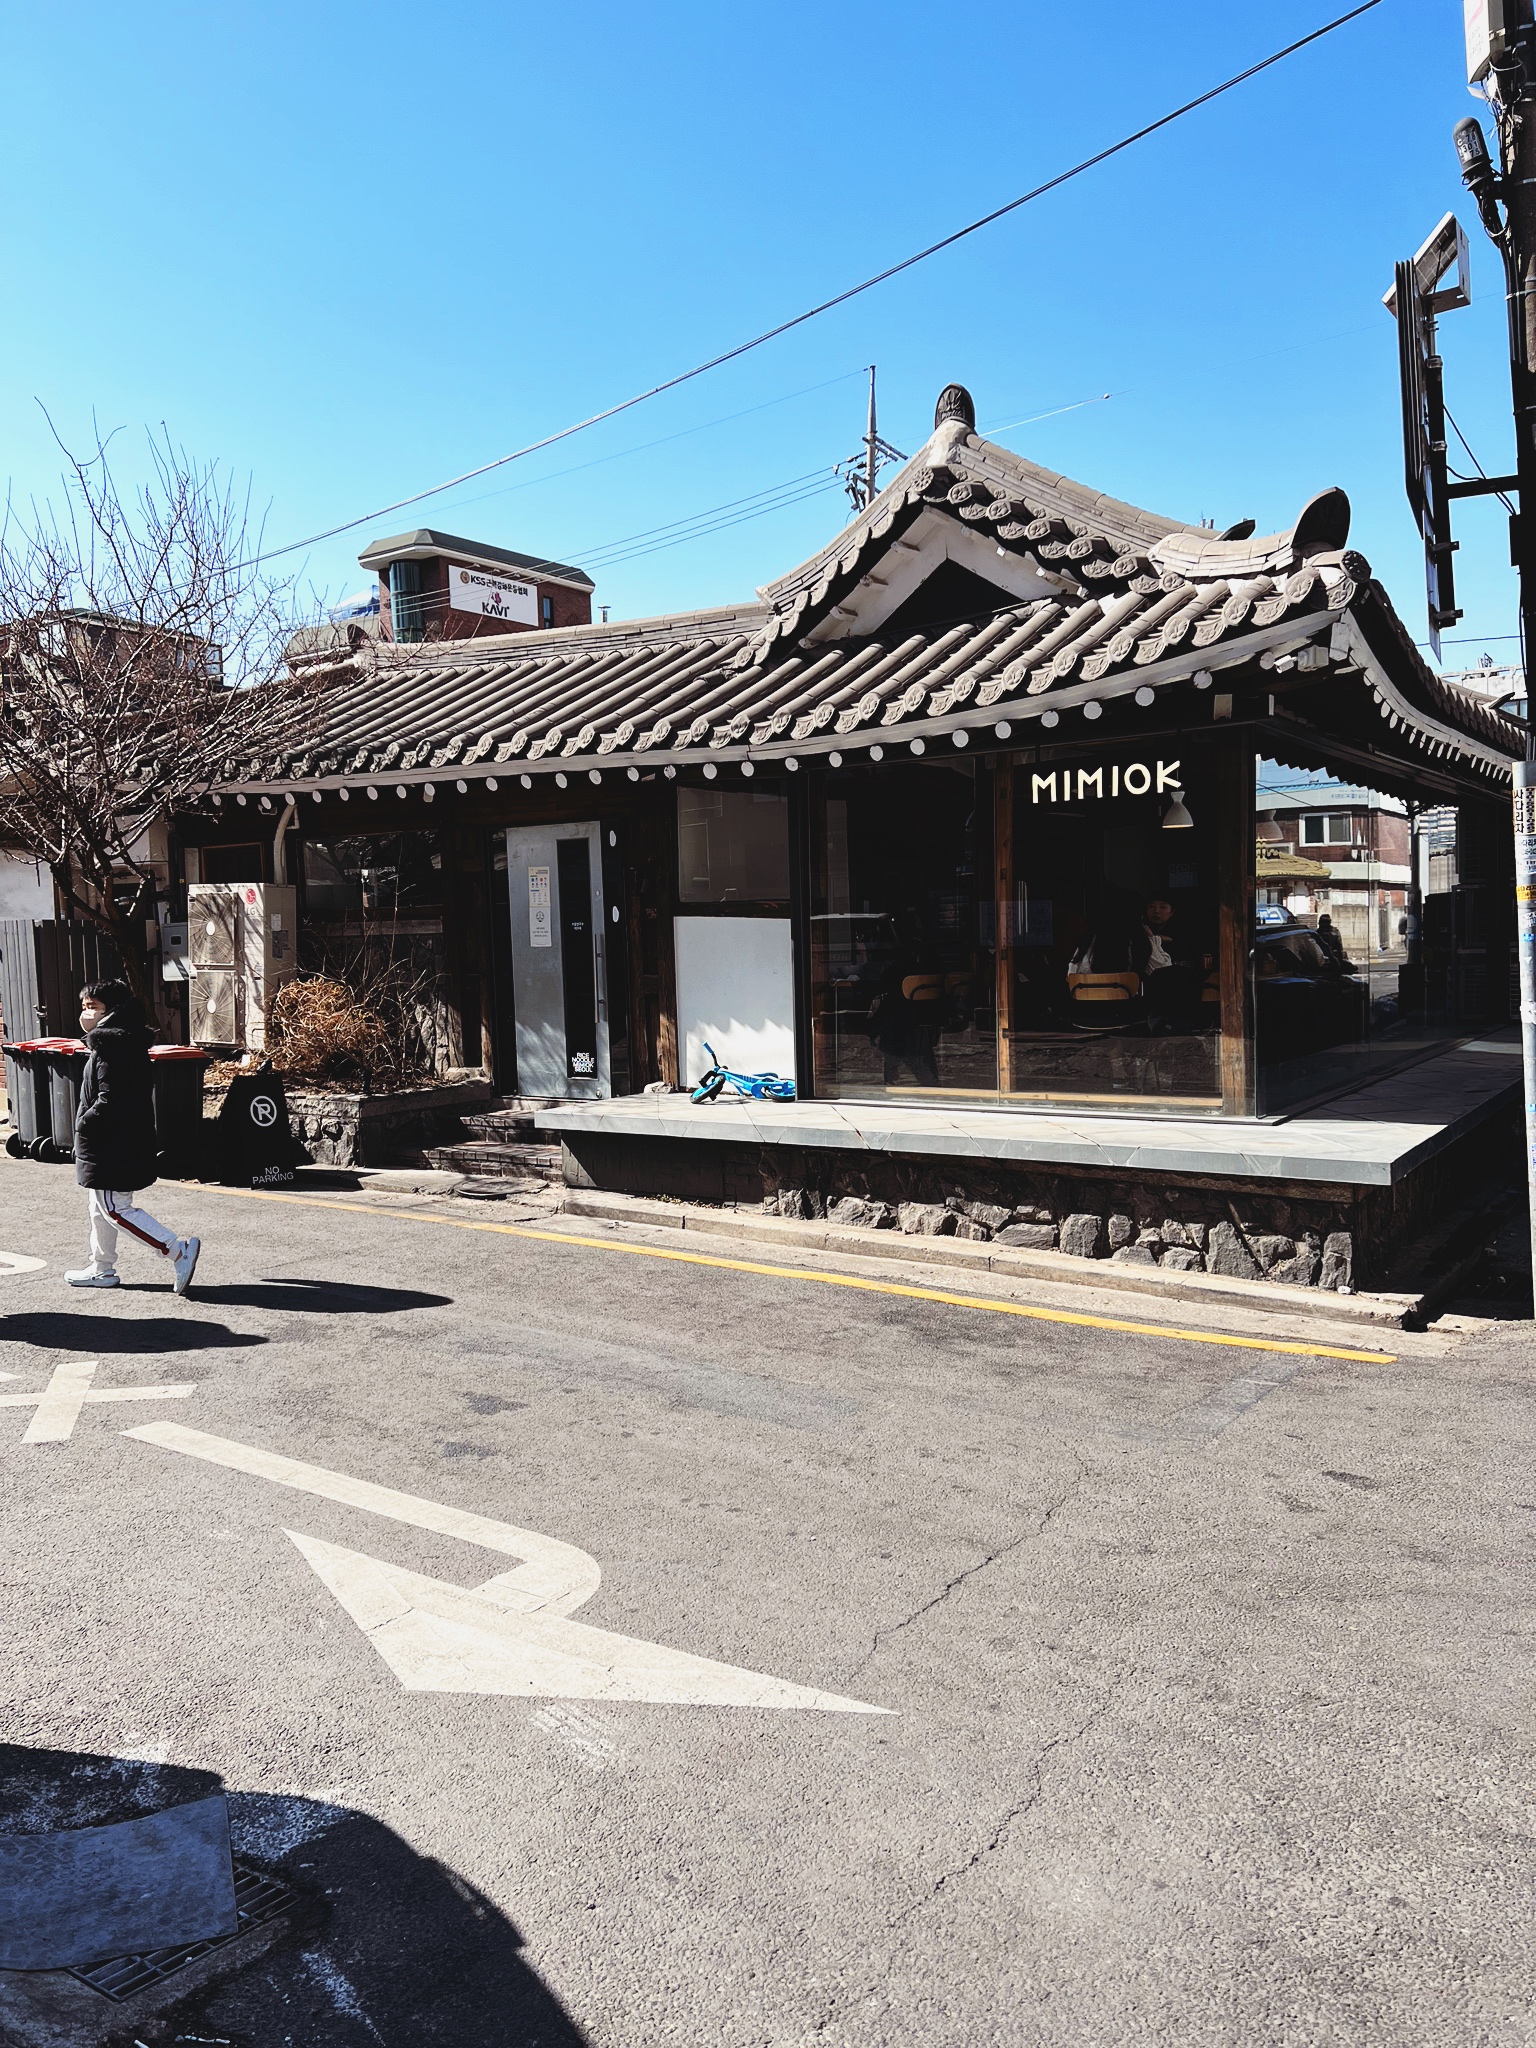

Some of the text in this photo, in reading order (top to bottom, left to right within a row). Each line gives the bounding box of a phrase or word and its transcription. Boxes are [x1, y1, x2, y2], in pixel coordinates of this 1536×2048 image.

[470, 574, 486, 587] KSS
[1031, 759, 1183, 804] MIMIOK
[246, 907, 256, 916] LG
[264, 1166, 280, 1175] NO
[252, 1172, 294, 1184] PARKING
